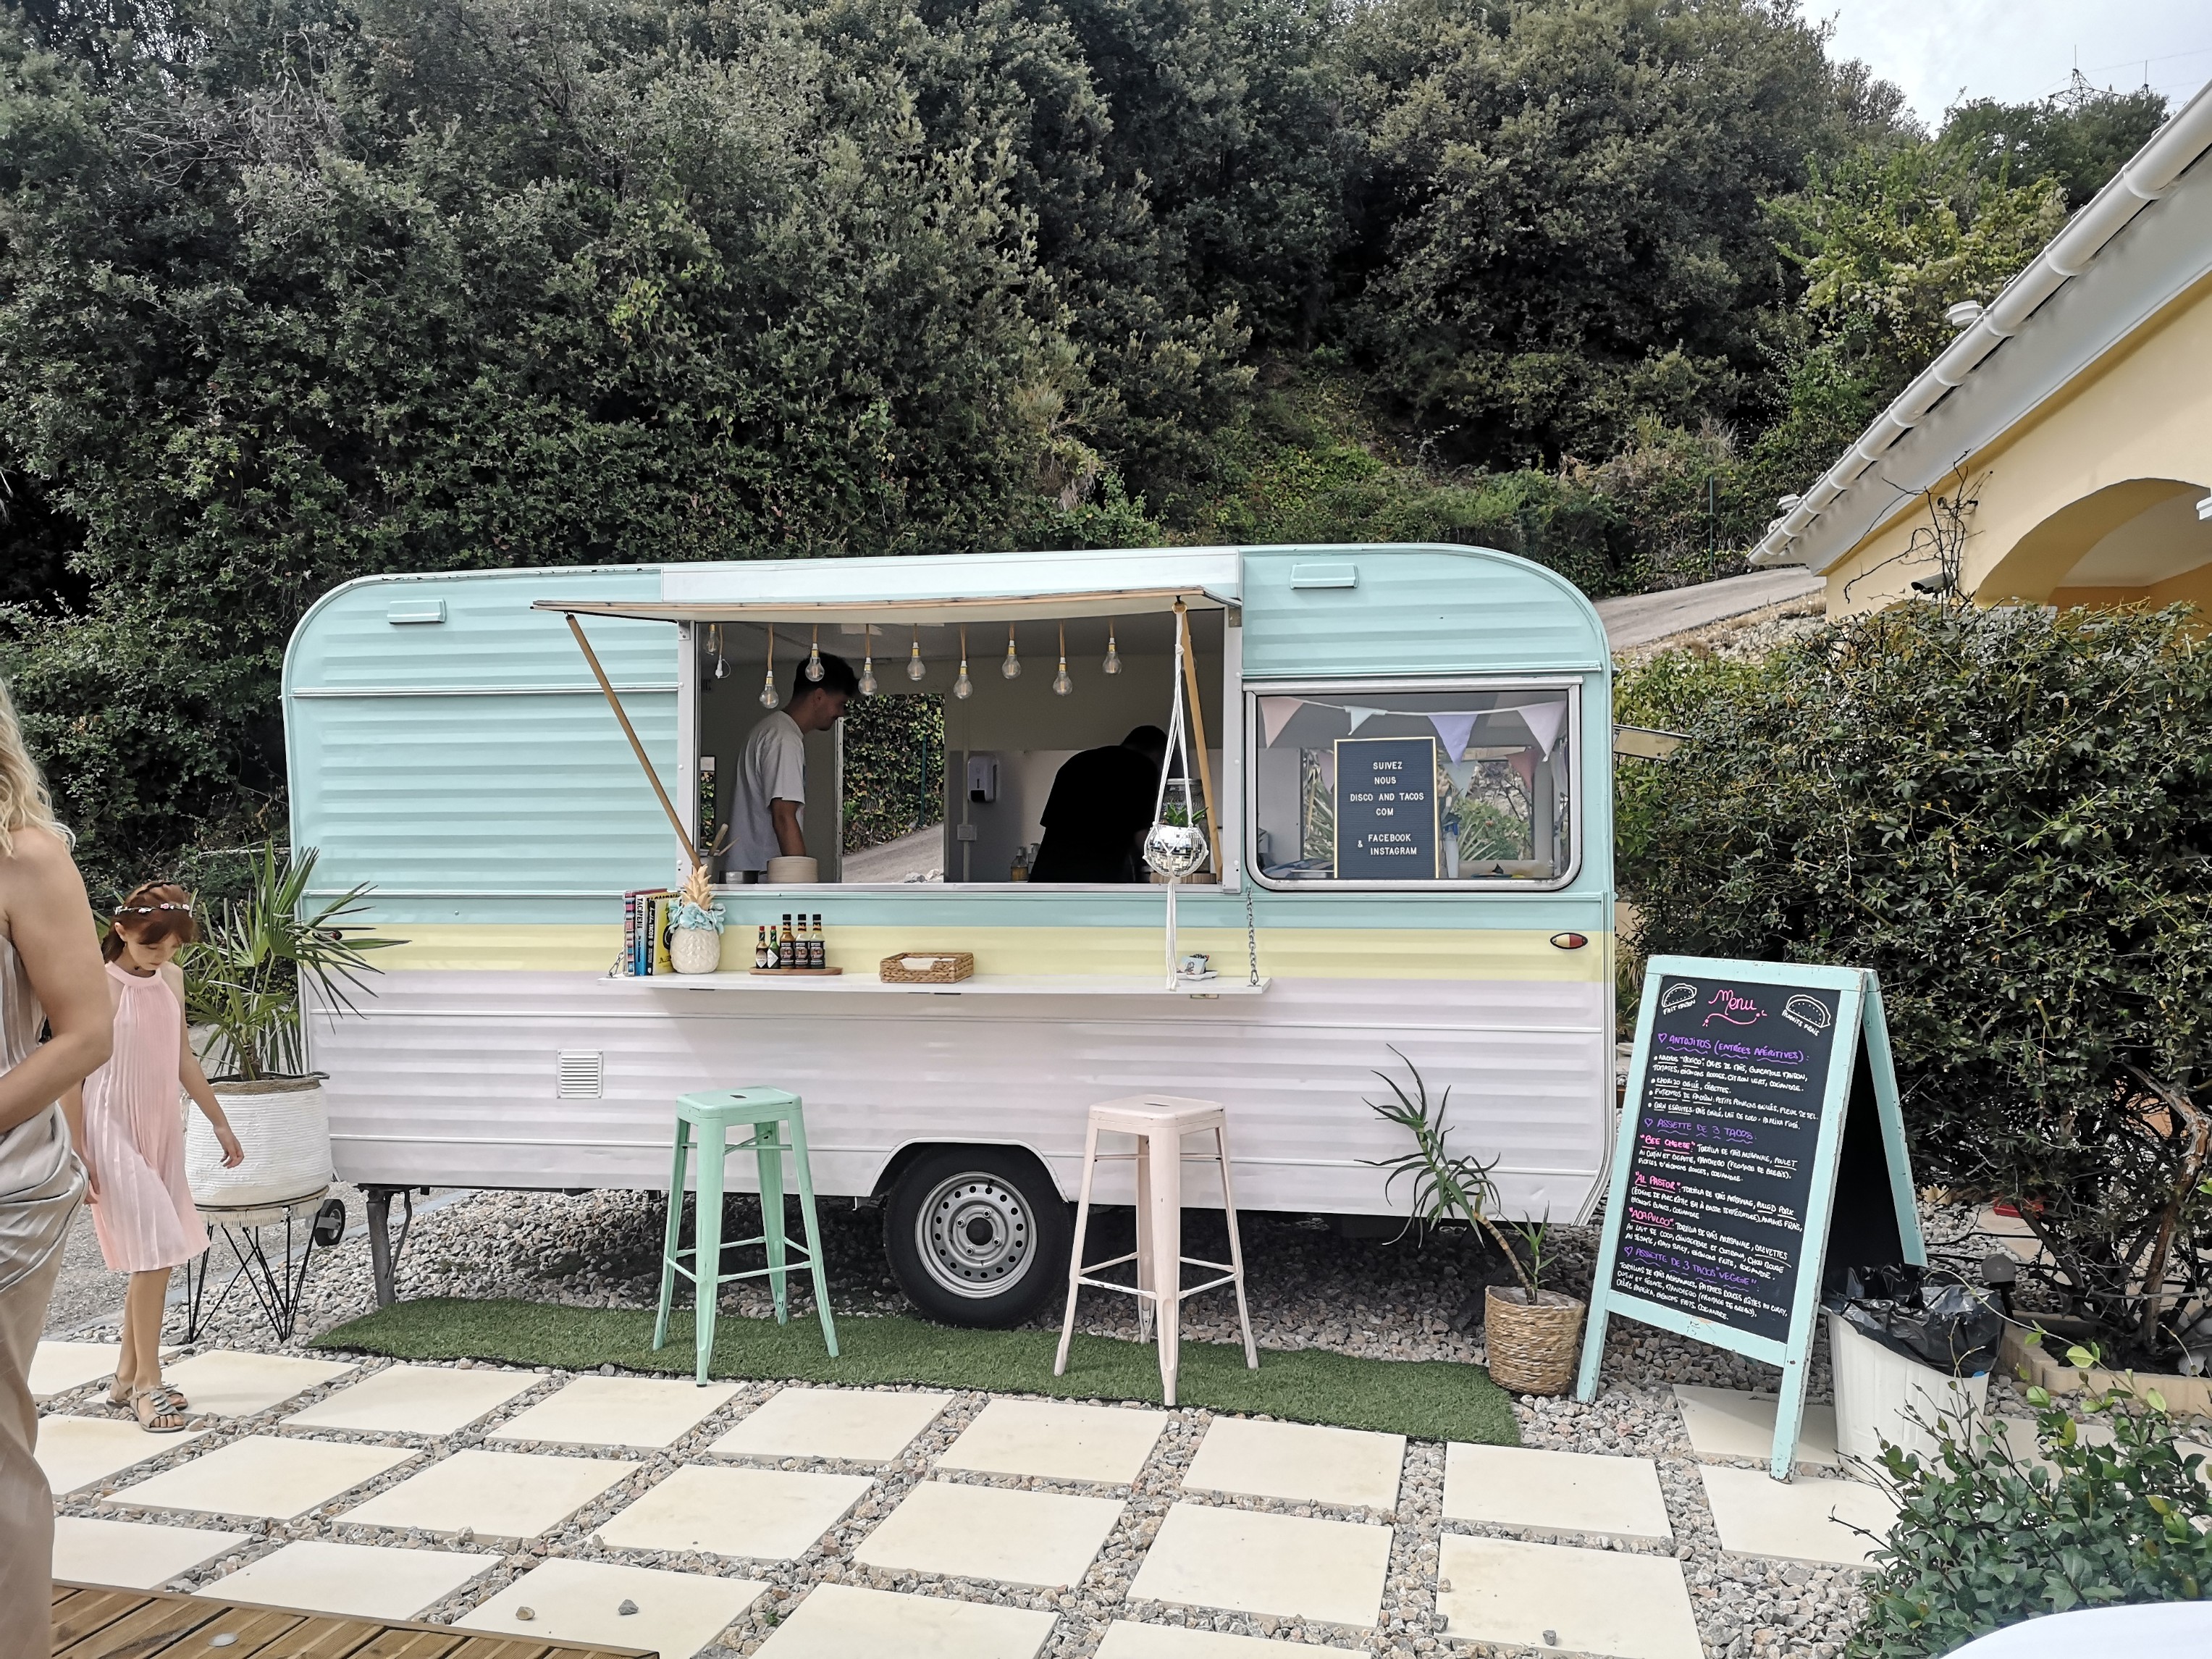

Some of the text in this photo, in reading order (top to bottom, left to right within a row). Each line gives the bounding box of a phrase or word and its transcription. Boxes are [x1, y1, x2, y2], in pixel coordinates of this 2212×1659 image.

[1373, 761, 1403, 770] SUIVEZ
[1374, 776, 1397, 785] NOUS
[1350, 793, 1374, 802] DISCO
[1399, 792, 1424, 801] TACOS
[1376, 807, 1394, 816] COM
[1368, 833, 1411, 842] FACEBOOK
[1370, 847, 1417, 855] INSTAGRAM
[1708, 989, 1757, 1015] Menu
[1669, 1035, 1711, 1049] ANTOJITOS
[1696, 1124, 1707, 1133] DE
[1712, 1125, 1720, 1134] 3
[1774, 1156, 1798, 1167] POULET
[1670, 1257, 1680, 1267] DE
[1682, 1260, 1689, 1270] 3
